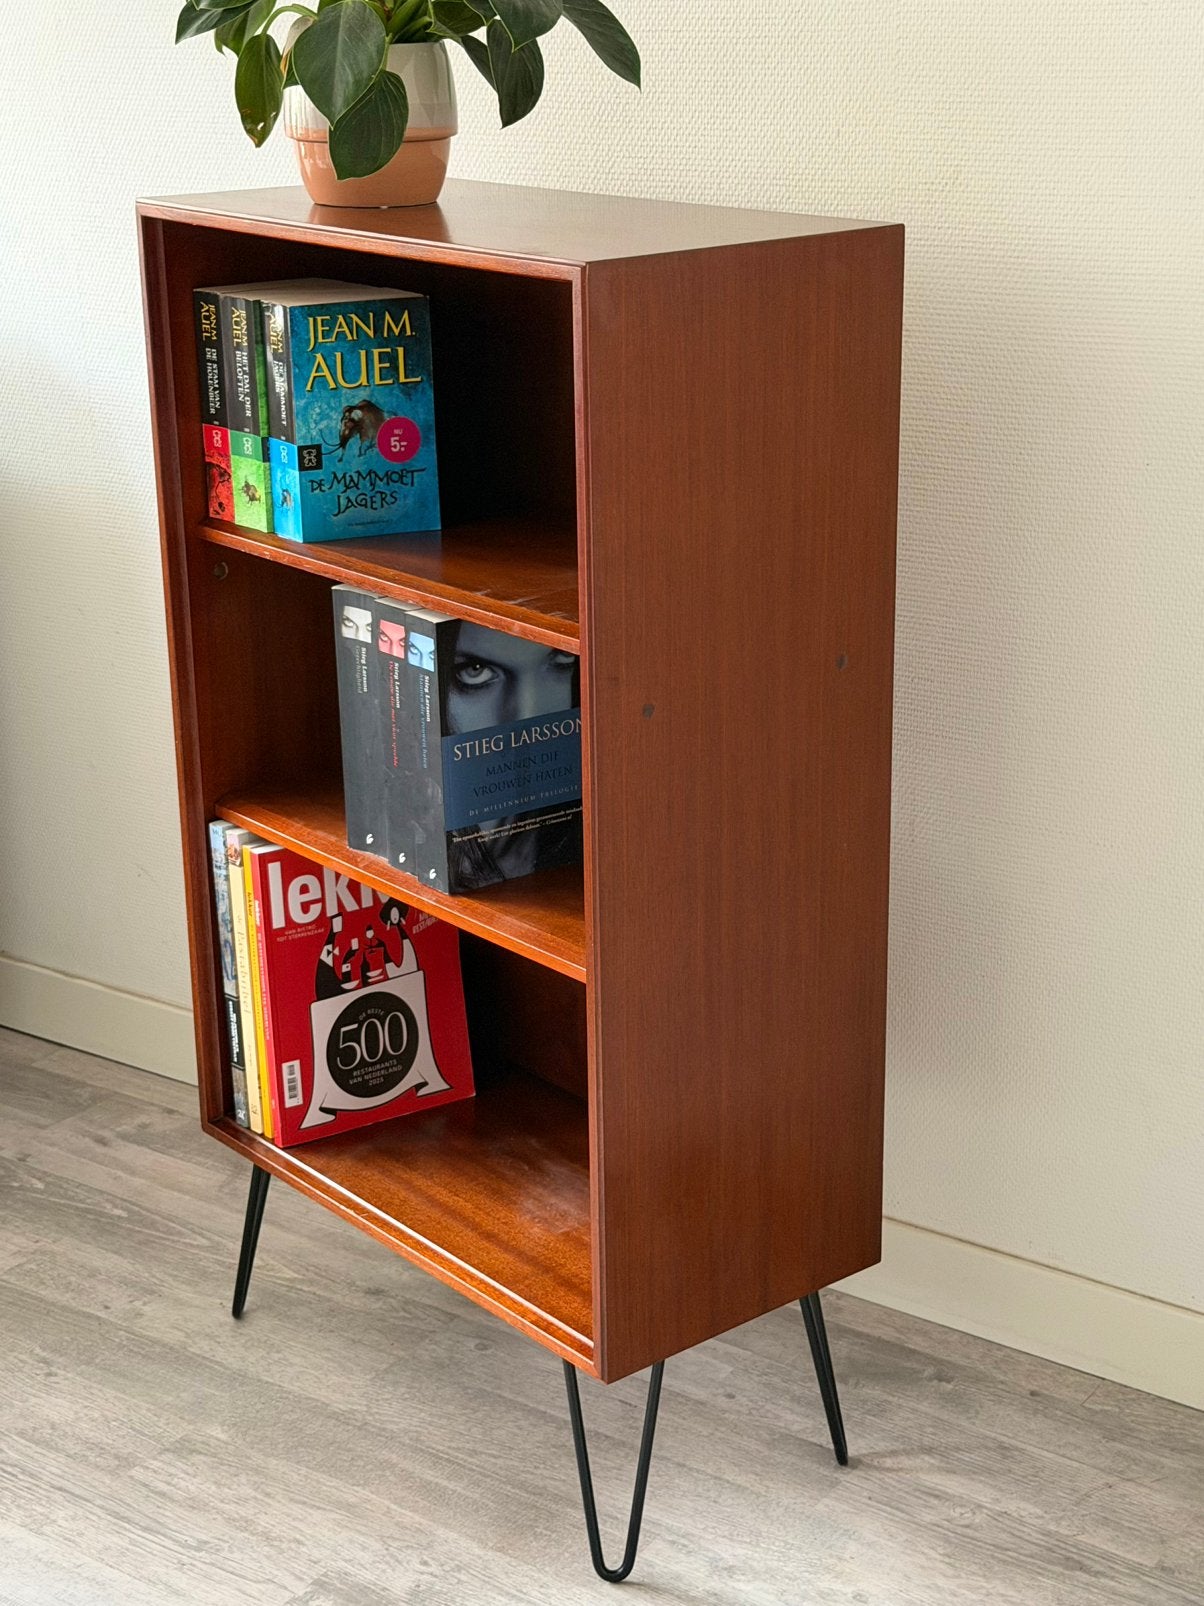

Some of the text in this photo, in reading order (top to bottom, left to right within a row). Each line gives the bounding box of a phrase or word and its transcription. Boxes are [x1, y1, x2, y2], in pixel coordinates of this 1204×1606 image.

[200, 301, 211, 341] AUEL
[208, 304, 218, 340] JEAN M
[231, 306, 242, 347] AUEL
[239, 309, 249, 346] JEAN M
[269, 313, 278, 354] AUEL
[306, 309, 417, 352] JEAN M.
[205, 347, 212, 360] DE
[211, 348, 218, 361] DE
[241, 352, 249, 372] HET
[305, 346, 422, 392] AUEL
[235, 350, 245, 402] BELOFTEN
[244, 396, 252, 417] DER
[308, 467, 427, 494] DE MAMMOET
[332, 490, 400, 517] JAGERS
[360, 647, 369, 693] Stieg Larsson
[423, 675, 431, 693] Stieg
[453, 734, 505, 761] STIEG
[484, 750, 560, 778] MANNEN DIE
[472, 764, 573, 798] VROUWEN HATEN
[337, 1011, 408, 1070] 500
[349, 1064, 403, 1085] VAN NEDERLAND
[353, 1058, 398, 1077] RESTAURANTS
